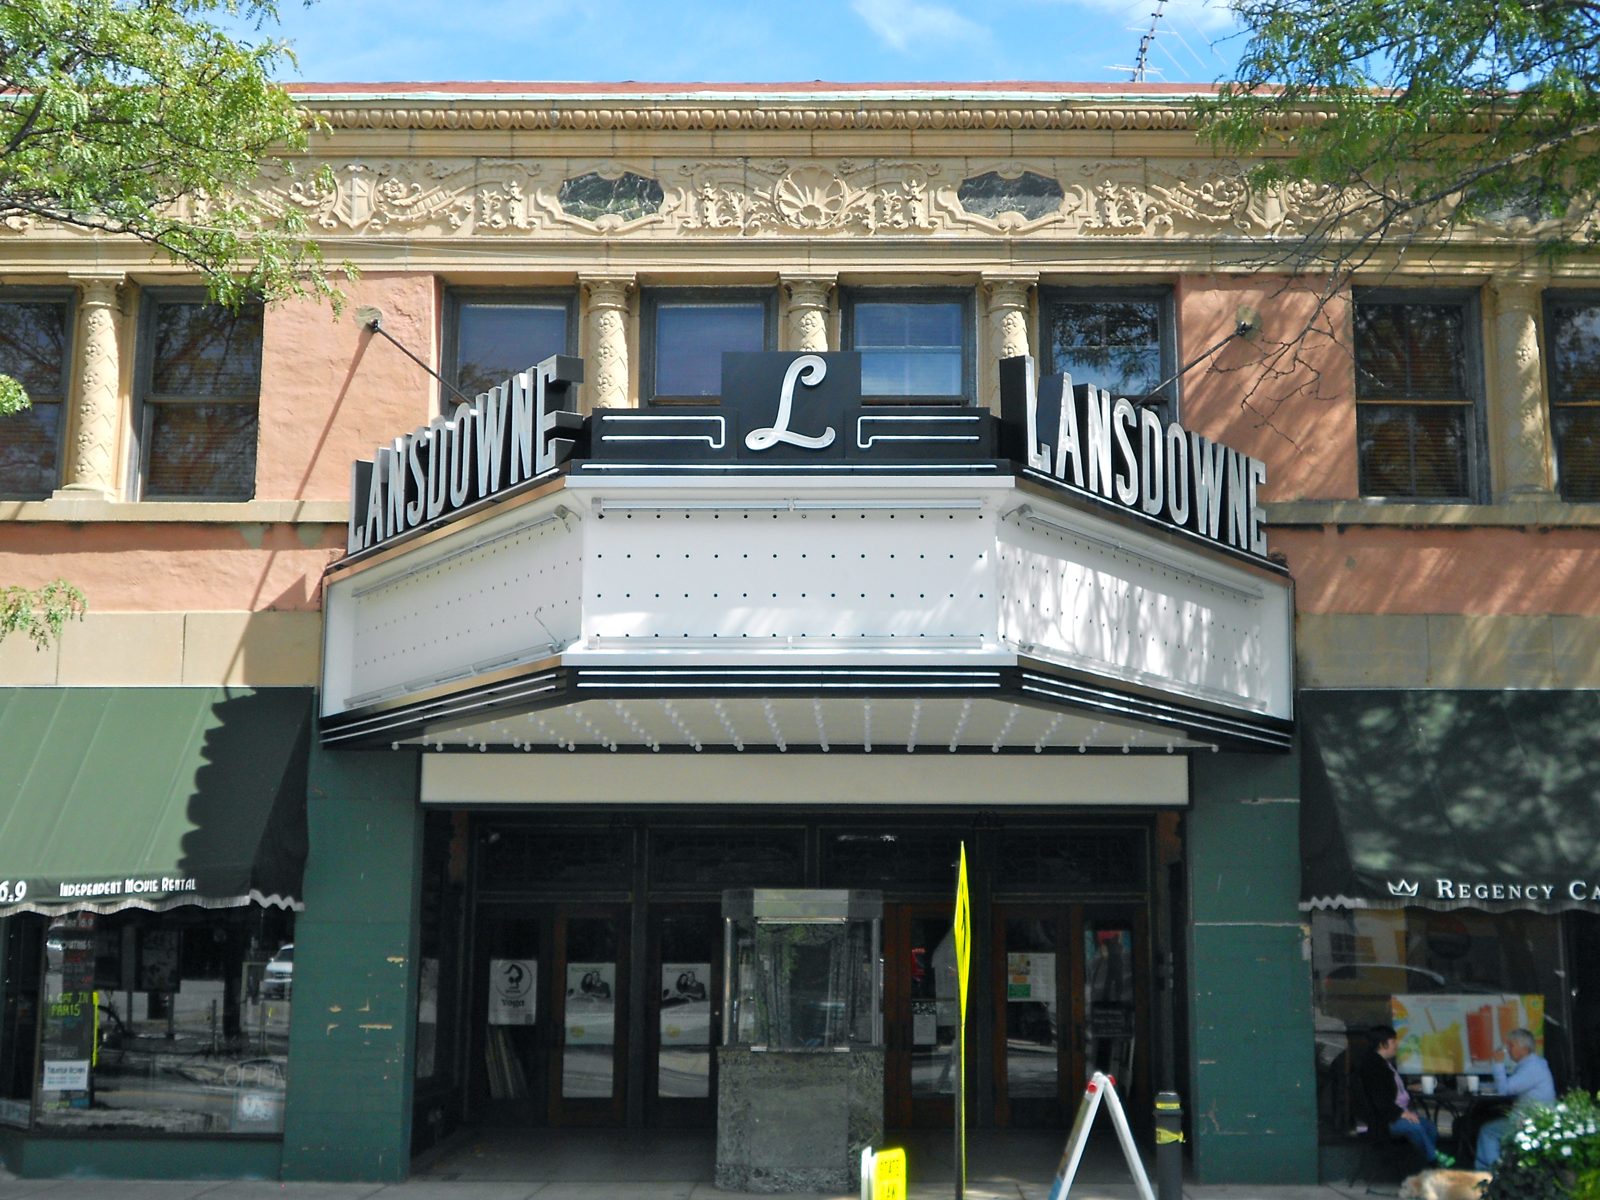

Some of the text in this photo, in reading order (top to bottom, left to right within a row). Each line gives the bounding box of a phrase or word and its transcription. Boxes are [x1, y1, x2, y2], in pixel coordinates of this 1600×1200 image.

[745, 355, 836, 450] L
[348, 355, 583, 554] LANSDOWNE
[1018, 355, 1268, 557] LANSDOWNE
[60, 876, 196, 897] INDEPENDENT MOVIE RENTAL
[1436, 879, 1554, 899] REGENCY
